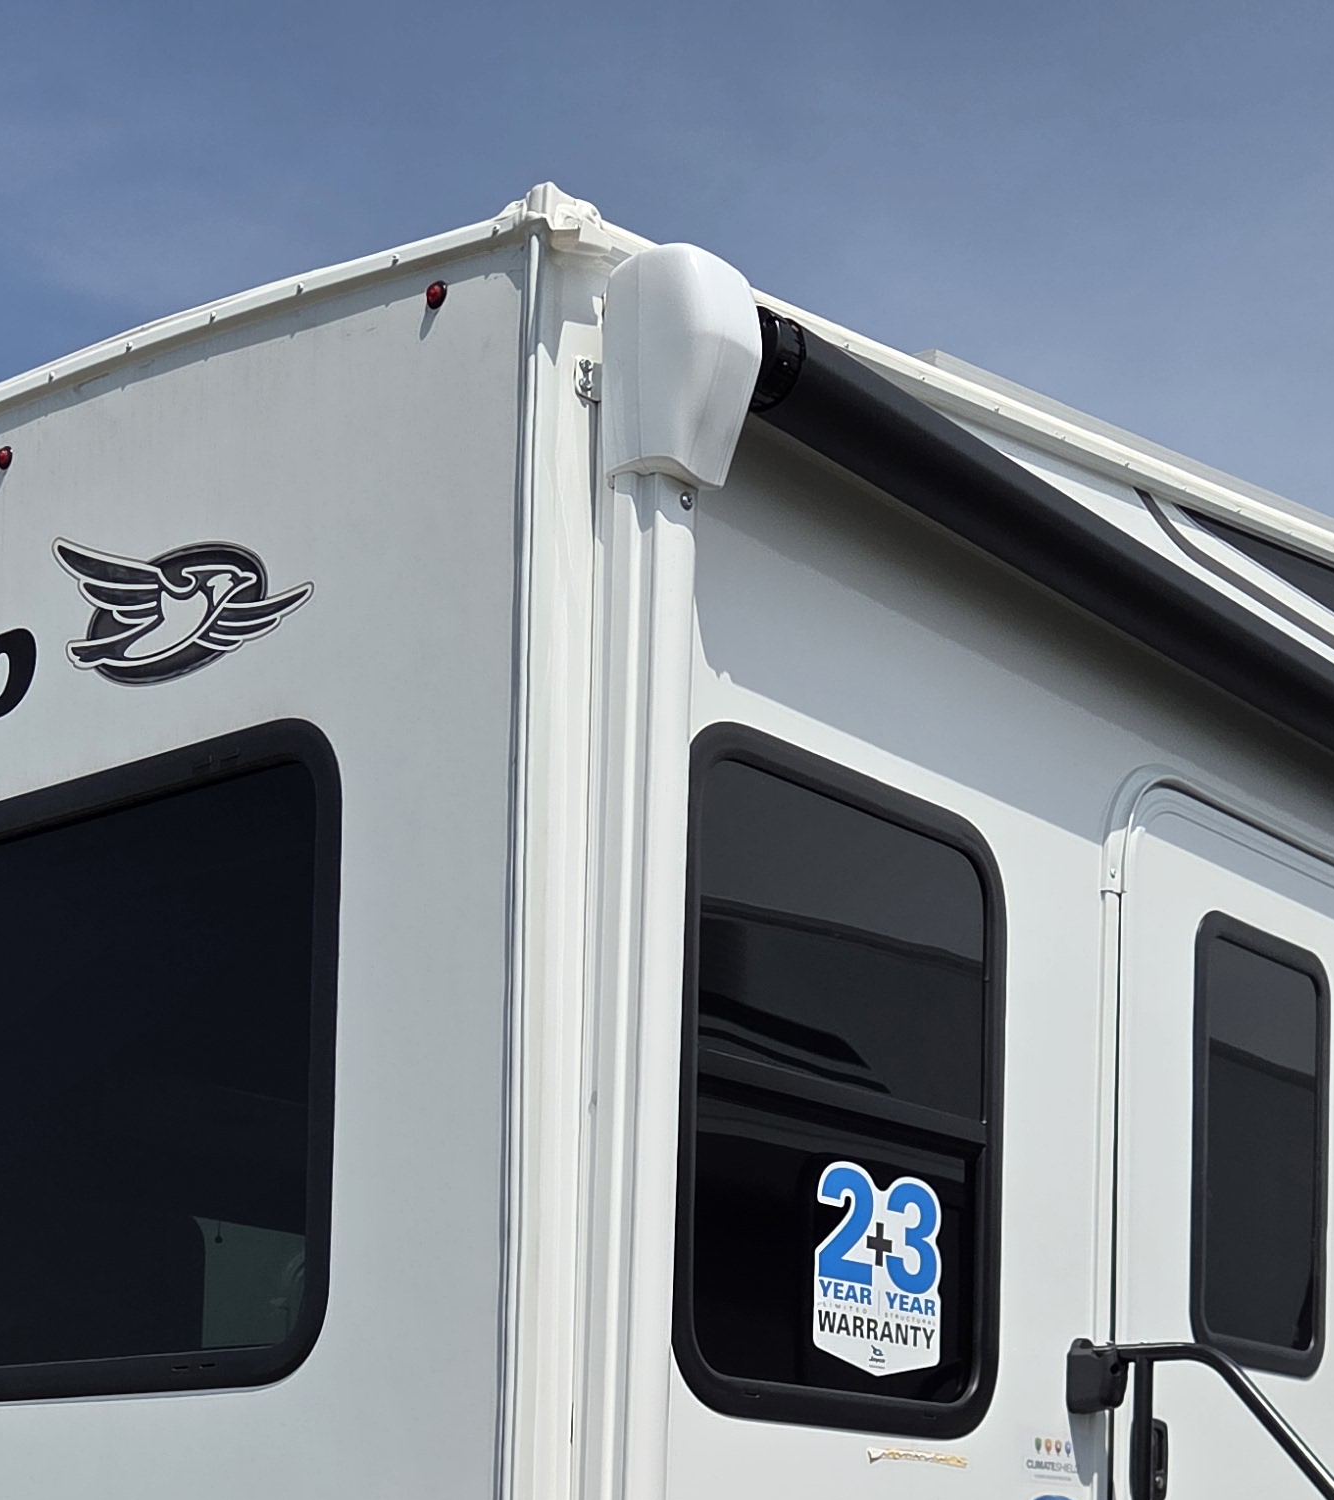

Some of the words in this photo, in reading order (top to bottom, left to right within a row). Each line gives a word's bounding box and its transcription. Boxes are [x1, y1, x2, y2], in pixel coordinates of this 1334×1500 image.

[818, 1279, 872, 1305] YEAR
[885, 1291, 936, 1317] YEAR
[818, 1309, 935, 1349] WARRANTY
